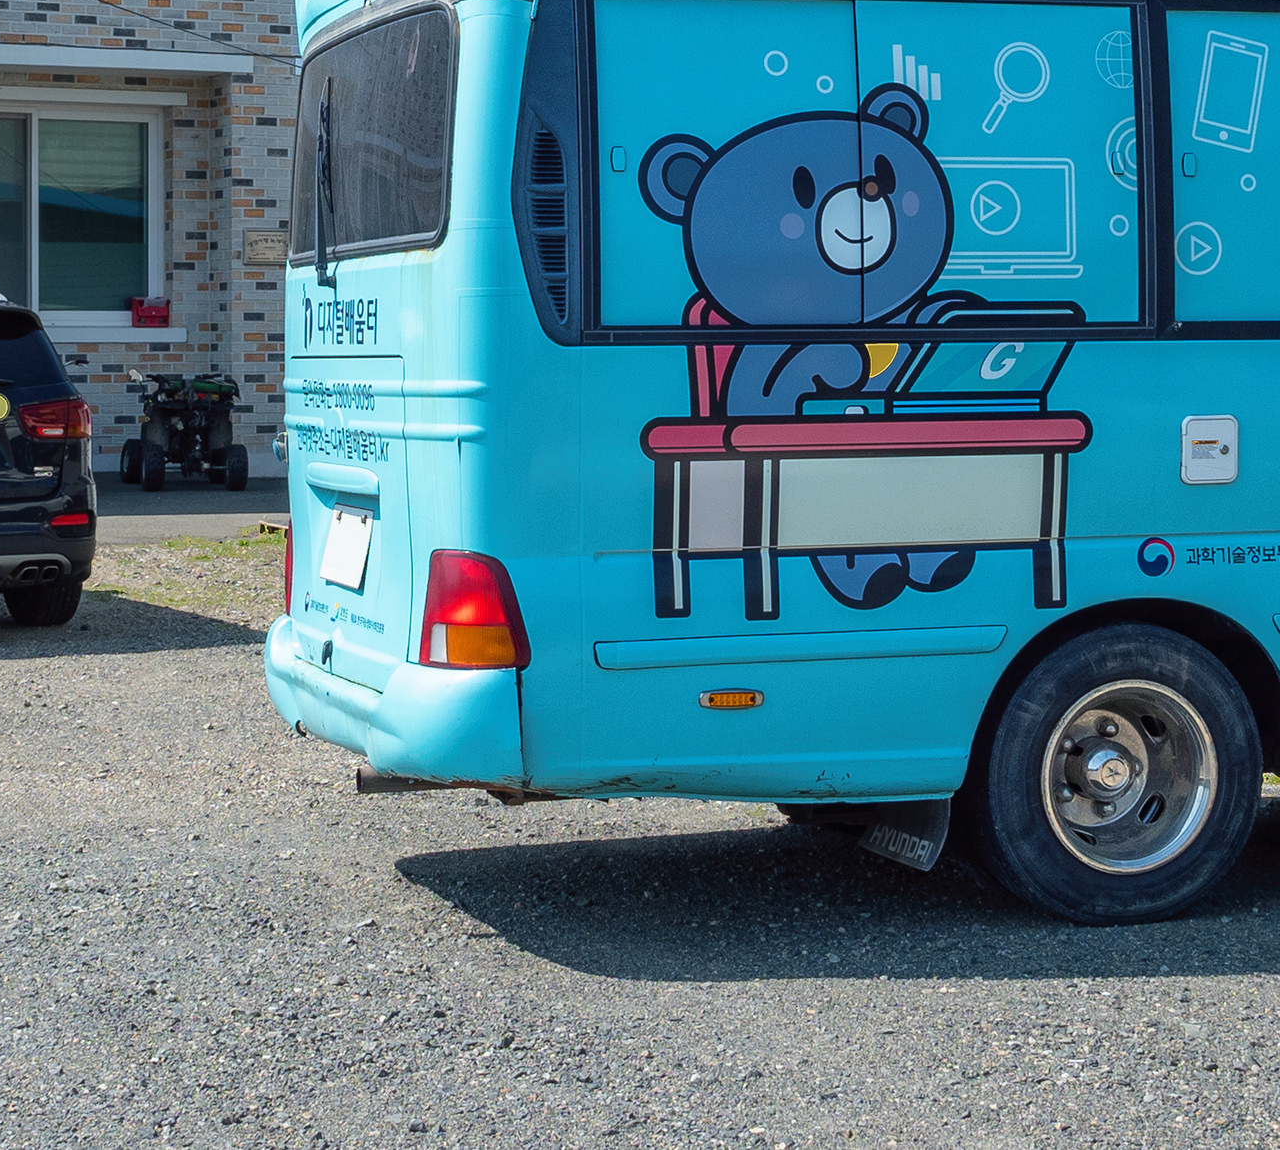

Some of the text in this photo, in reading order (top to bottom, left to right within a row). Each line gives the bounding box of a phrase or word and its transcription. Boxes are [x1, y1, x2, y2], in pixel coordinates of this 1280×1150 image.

[317, 298, 378, 345] 디지털배움터
[980, 341, 1025, 380] G
[869, 823, 934, 864] HYUNDAI
